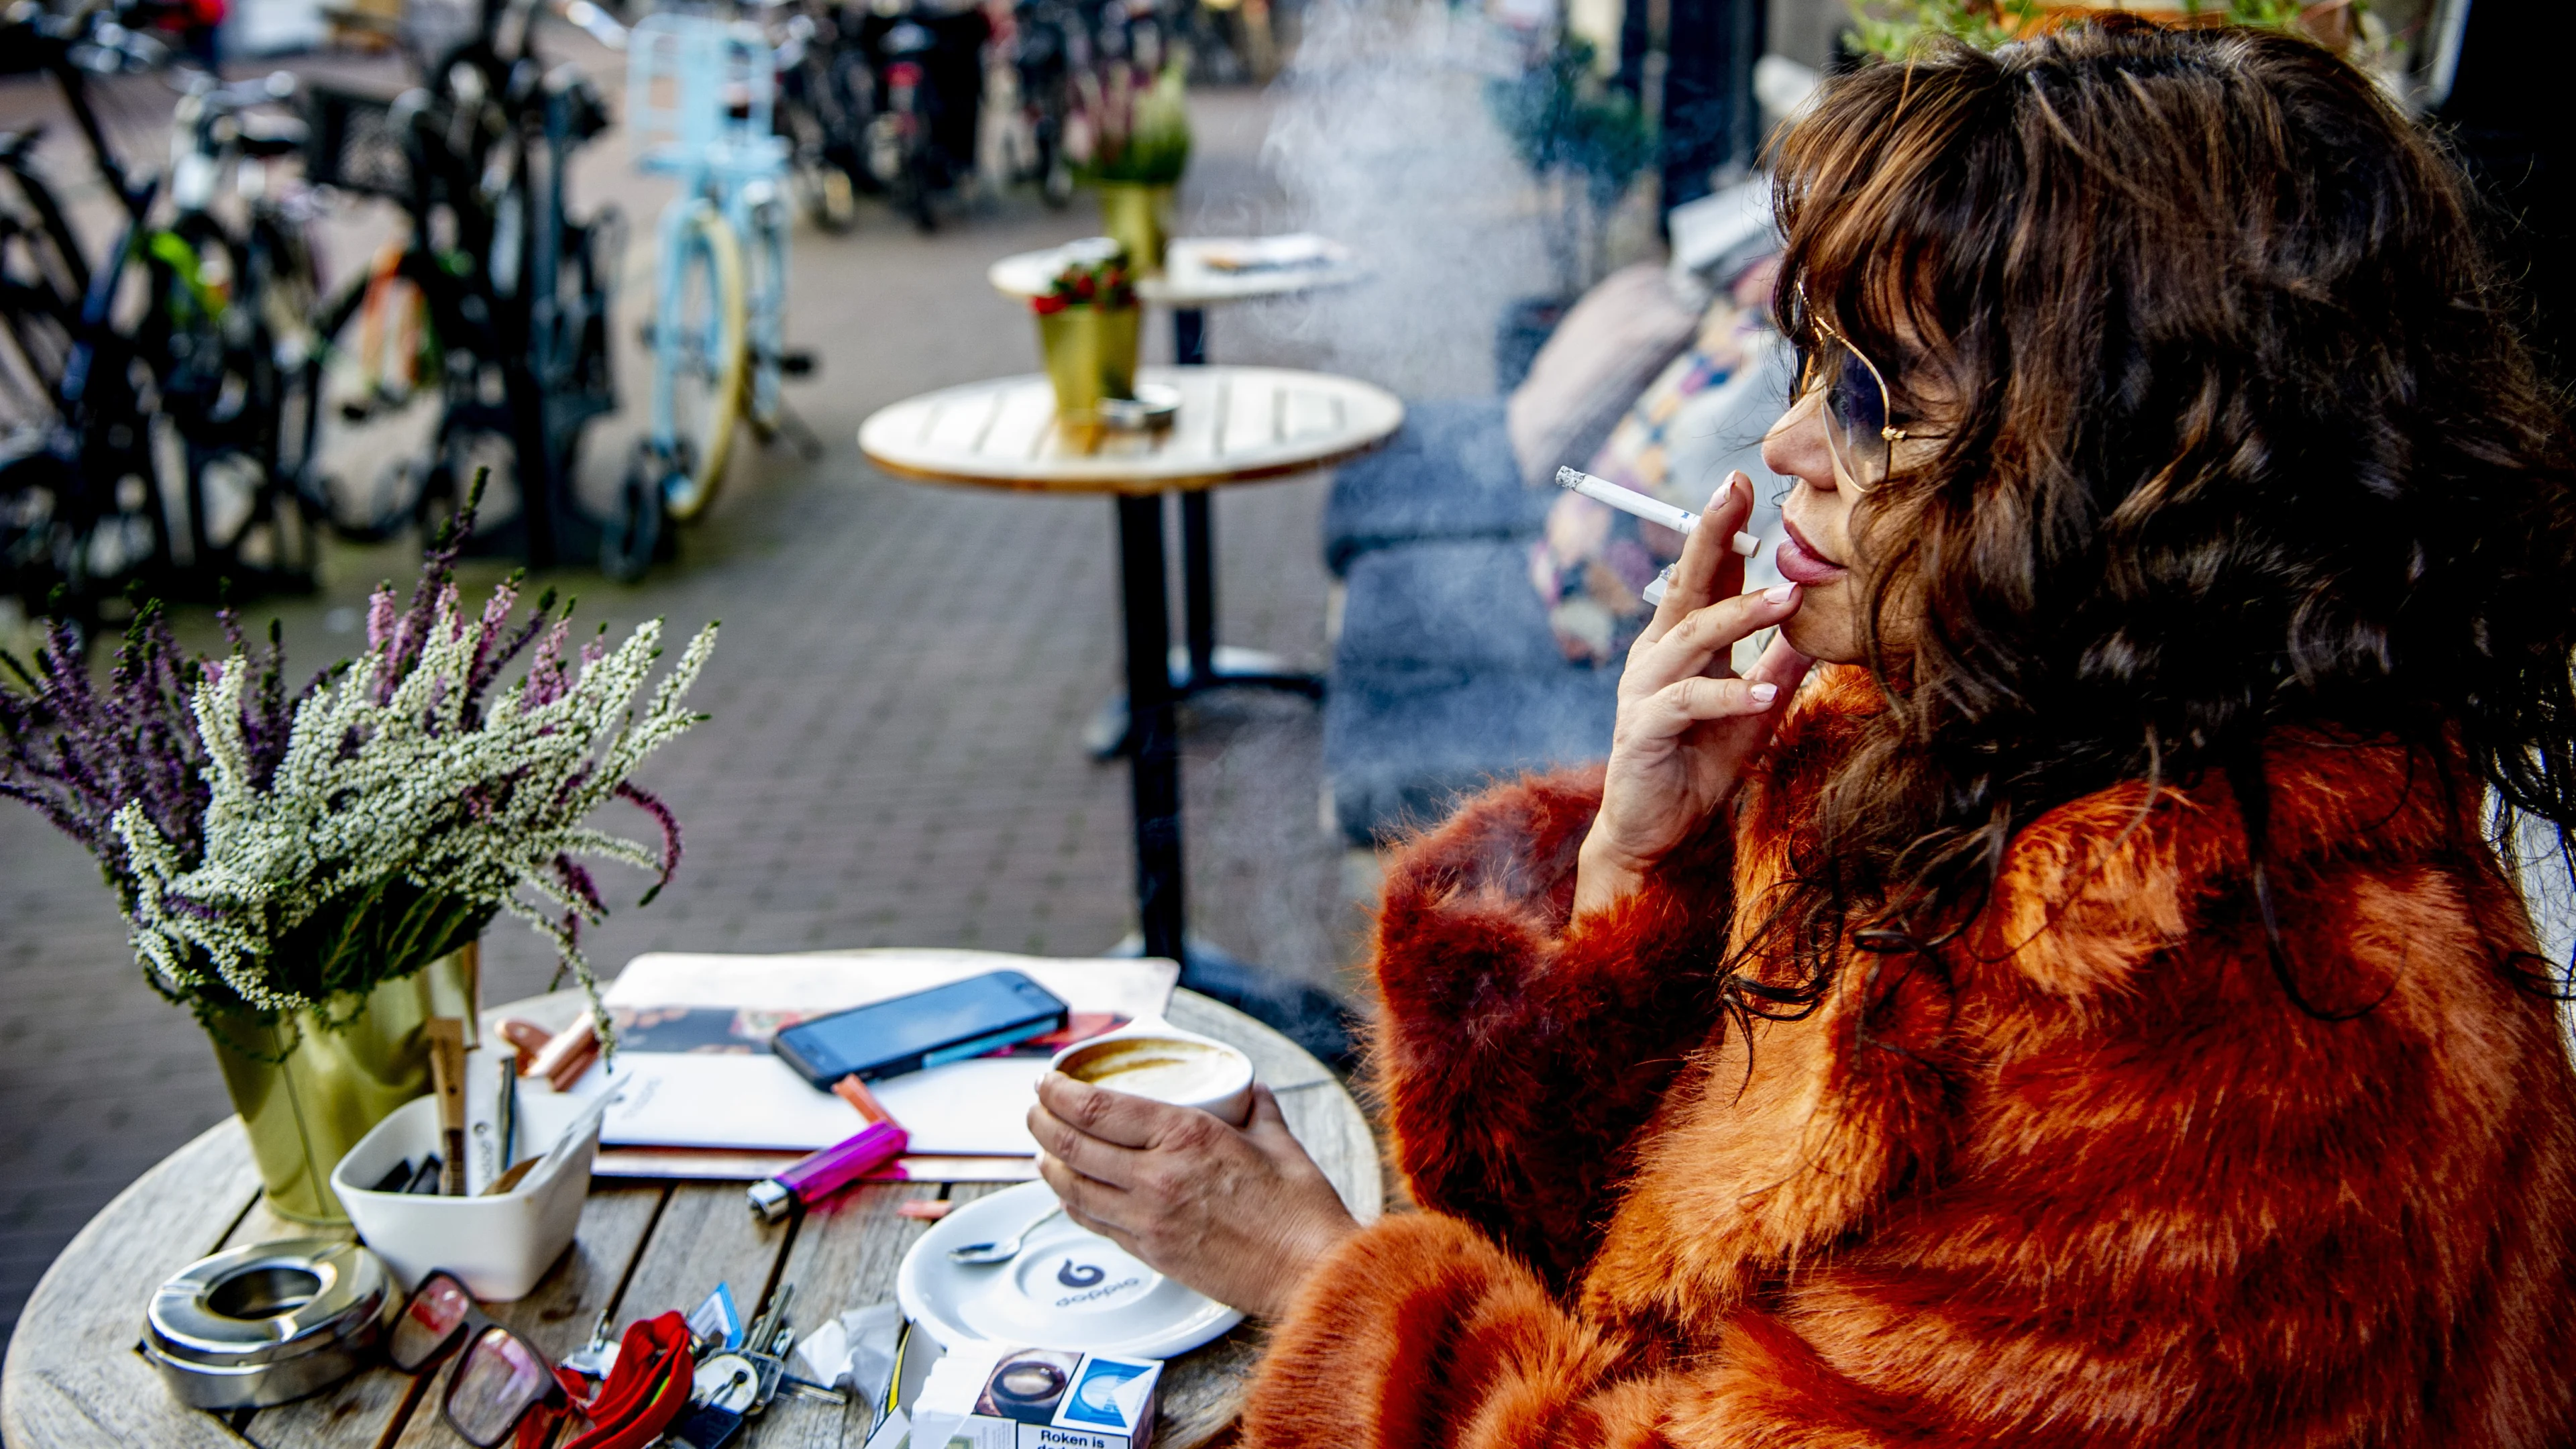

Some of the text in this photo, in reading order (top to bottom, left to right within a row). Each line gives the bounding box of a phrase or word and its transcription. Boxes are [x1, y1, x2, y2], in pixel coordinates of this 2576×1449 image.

[1055, 1277, 1139, 1307] doppio
[1040, 1430, 1105, 1448] Roken is
